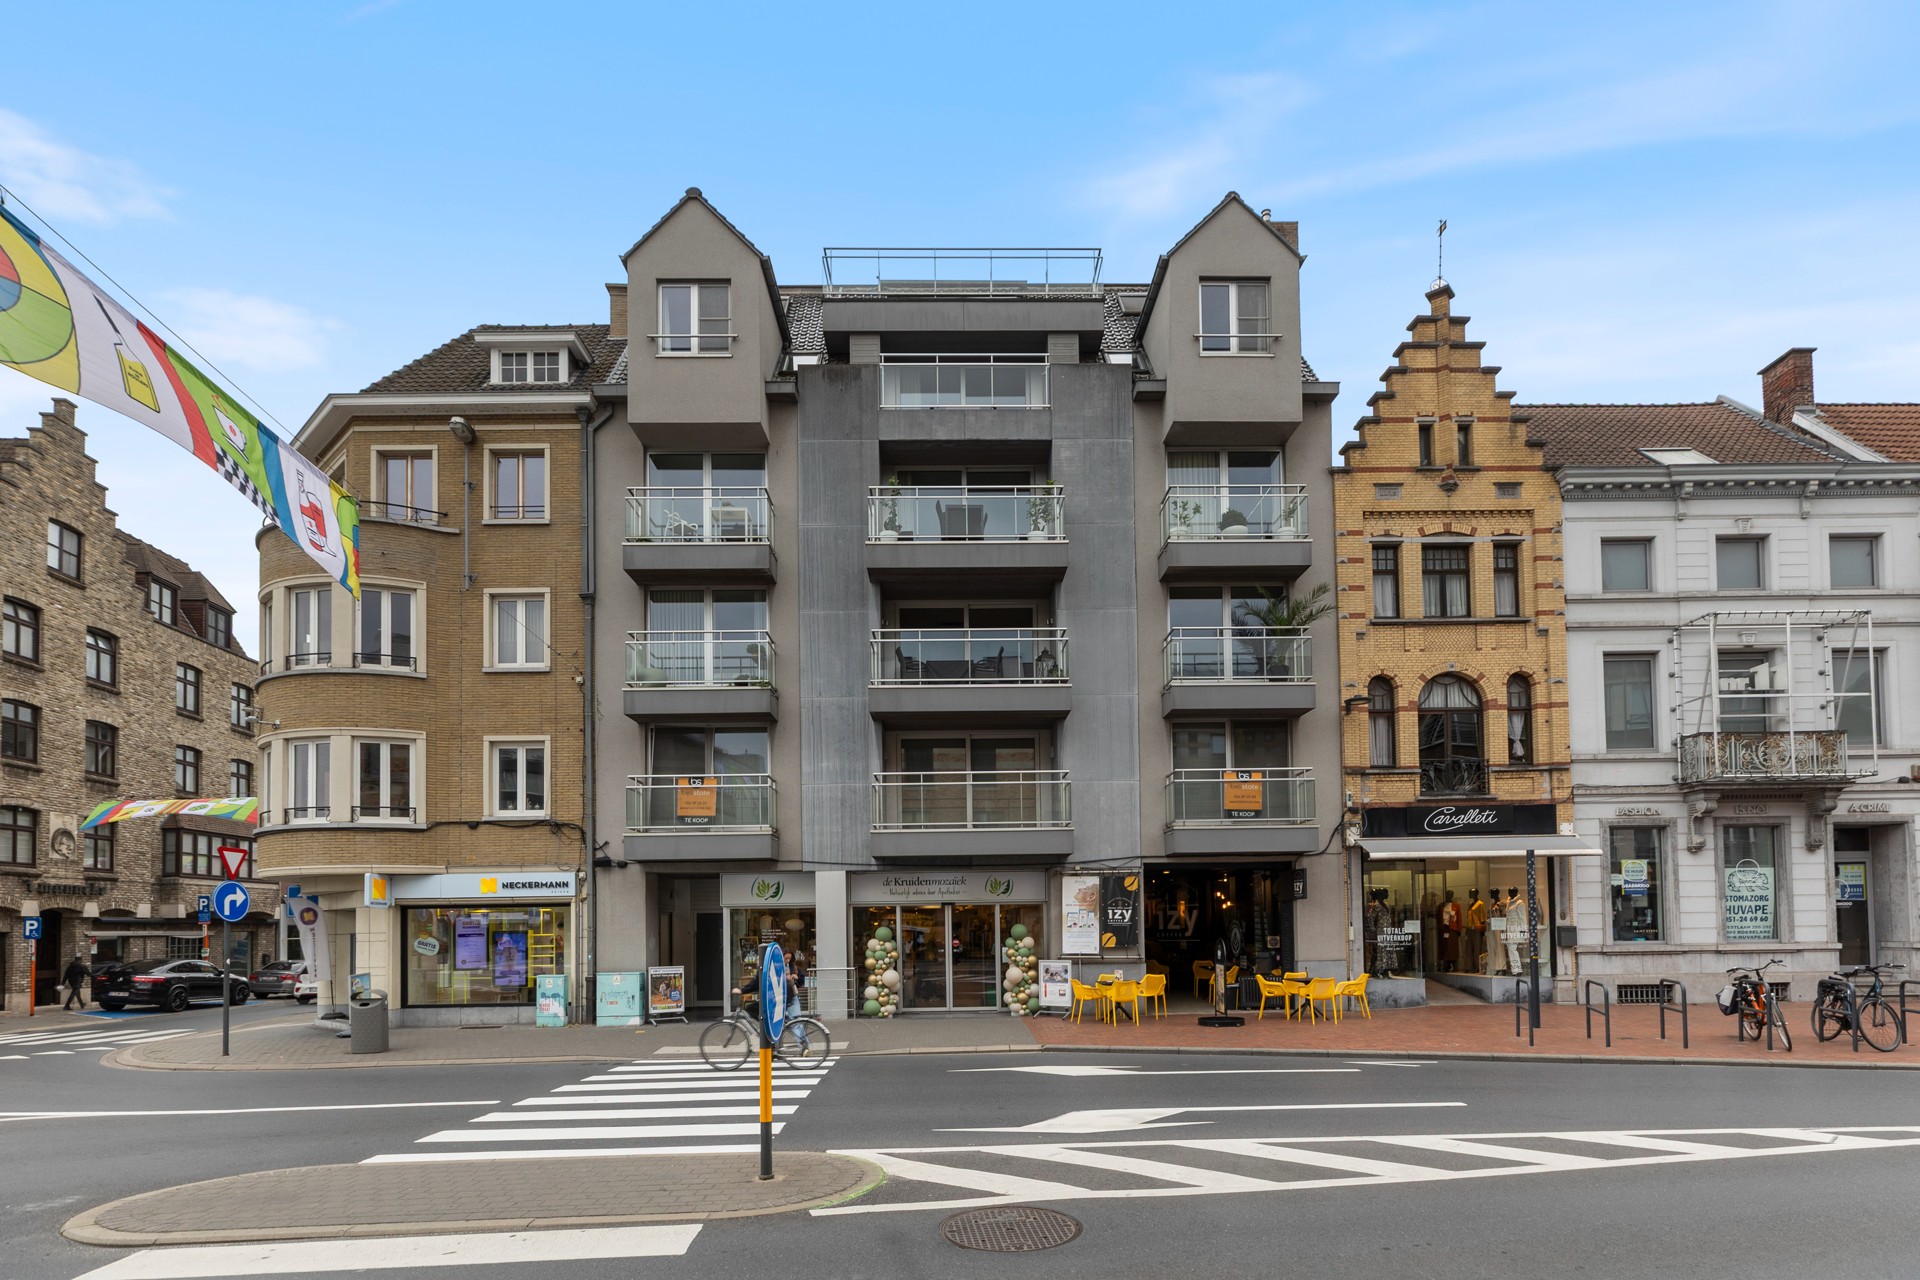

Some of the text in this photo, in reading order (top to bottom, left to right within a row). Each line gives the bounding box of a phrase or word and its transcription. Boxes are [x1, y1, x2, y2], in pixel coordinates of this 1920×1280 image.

[1615, 806, 1662, 816] FASHION
[1424, 806, 1498, 832] Cavalleti
[502, 881, 569, 889] NECKERMANN
[882, 876, 892, 886] de
[1725, 894, 1769, 902] STOMAZORG
[25, 920, 38, 936] P
[418, 940, 436, 949] GRATIS
